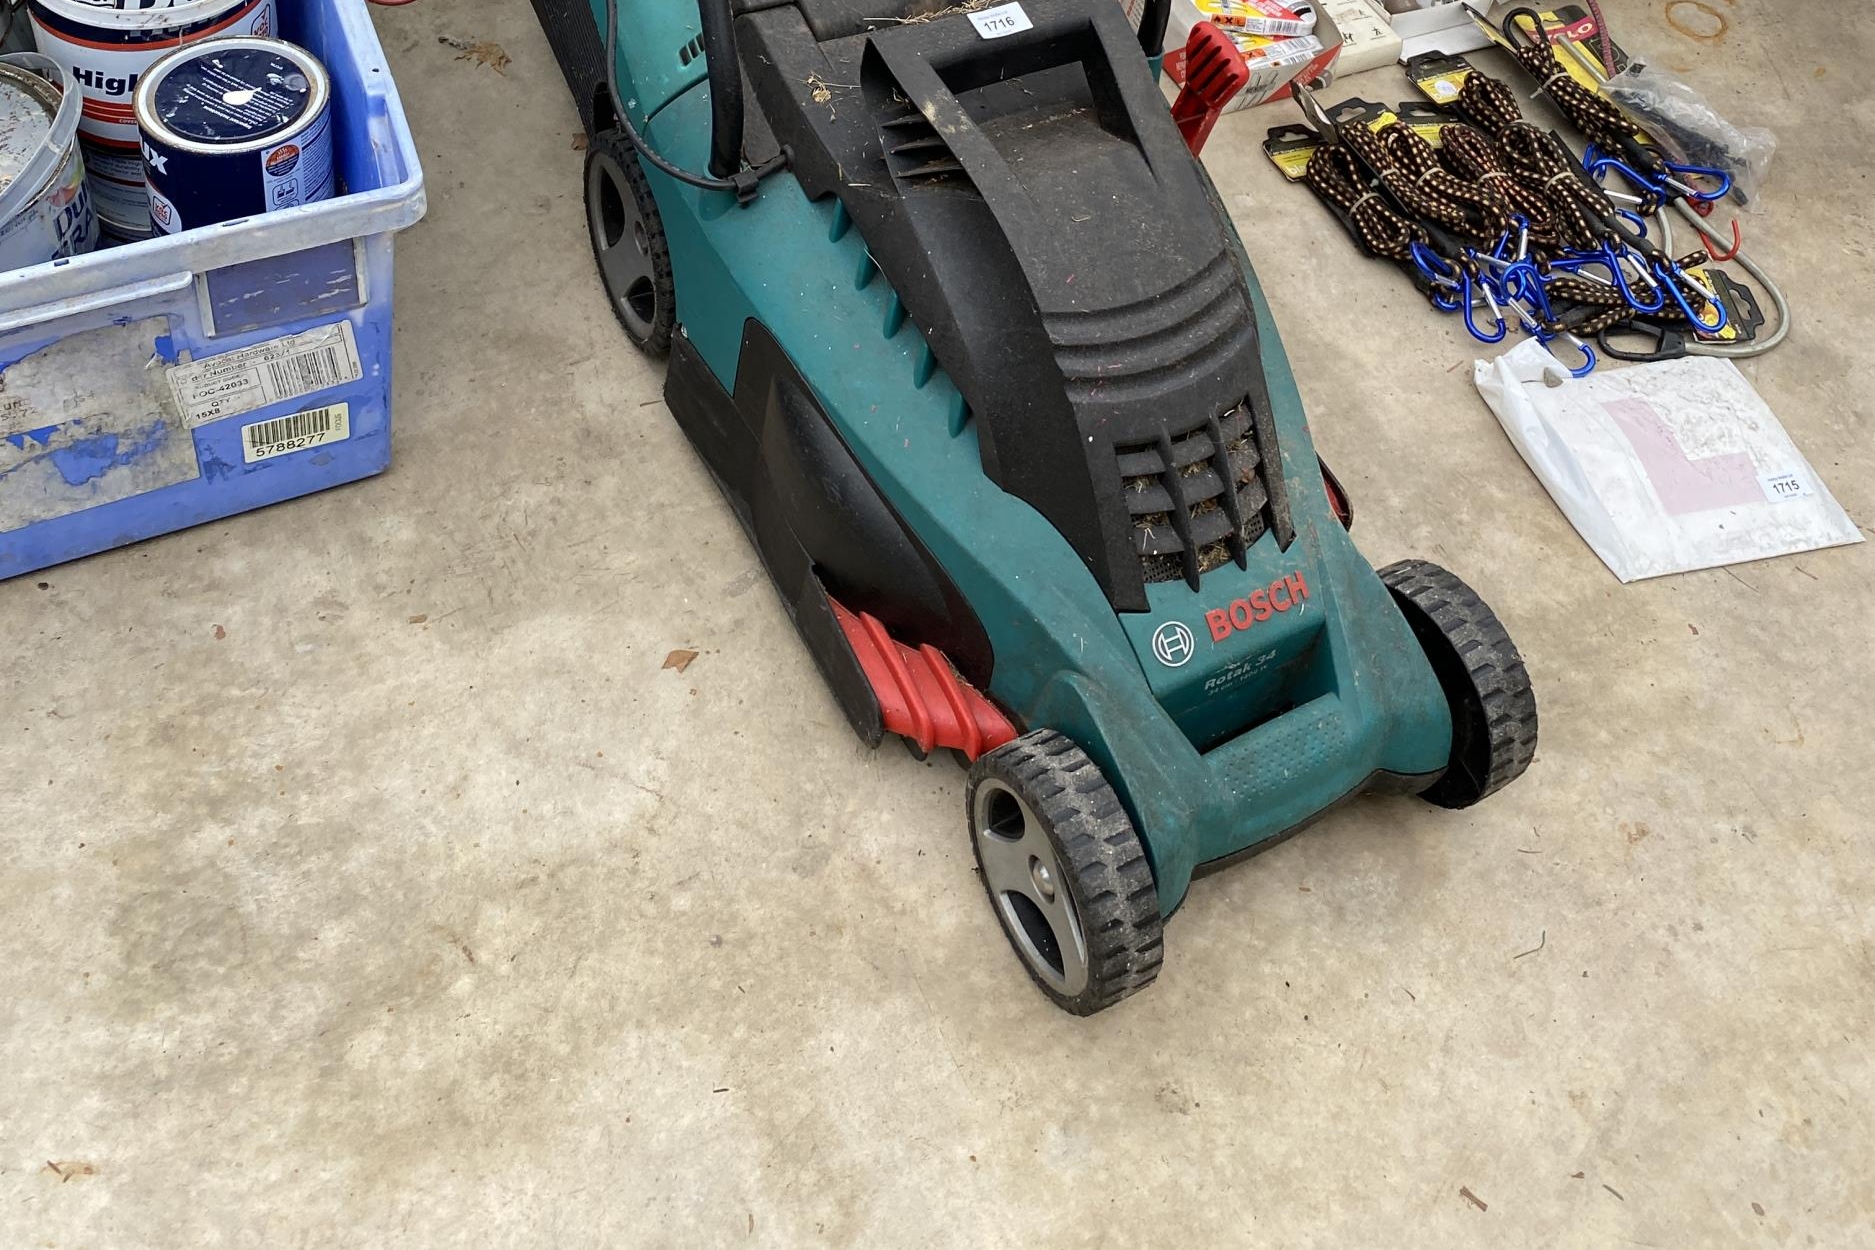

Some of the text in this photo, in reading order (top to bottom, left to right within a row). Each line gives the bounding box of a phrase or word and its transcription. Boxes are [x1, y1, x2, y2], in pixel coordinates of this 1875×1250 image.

[984, 16, 1014, 31] 1716
[195, 408, 221, 419] 15X8
[256, 432, 326, 457] 5788277
[1773, 480, 1800, 494] 1715
[1204, 570, 1310, 643] BOSCH
[1204, 650, 1277, 691] Rotak 34
